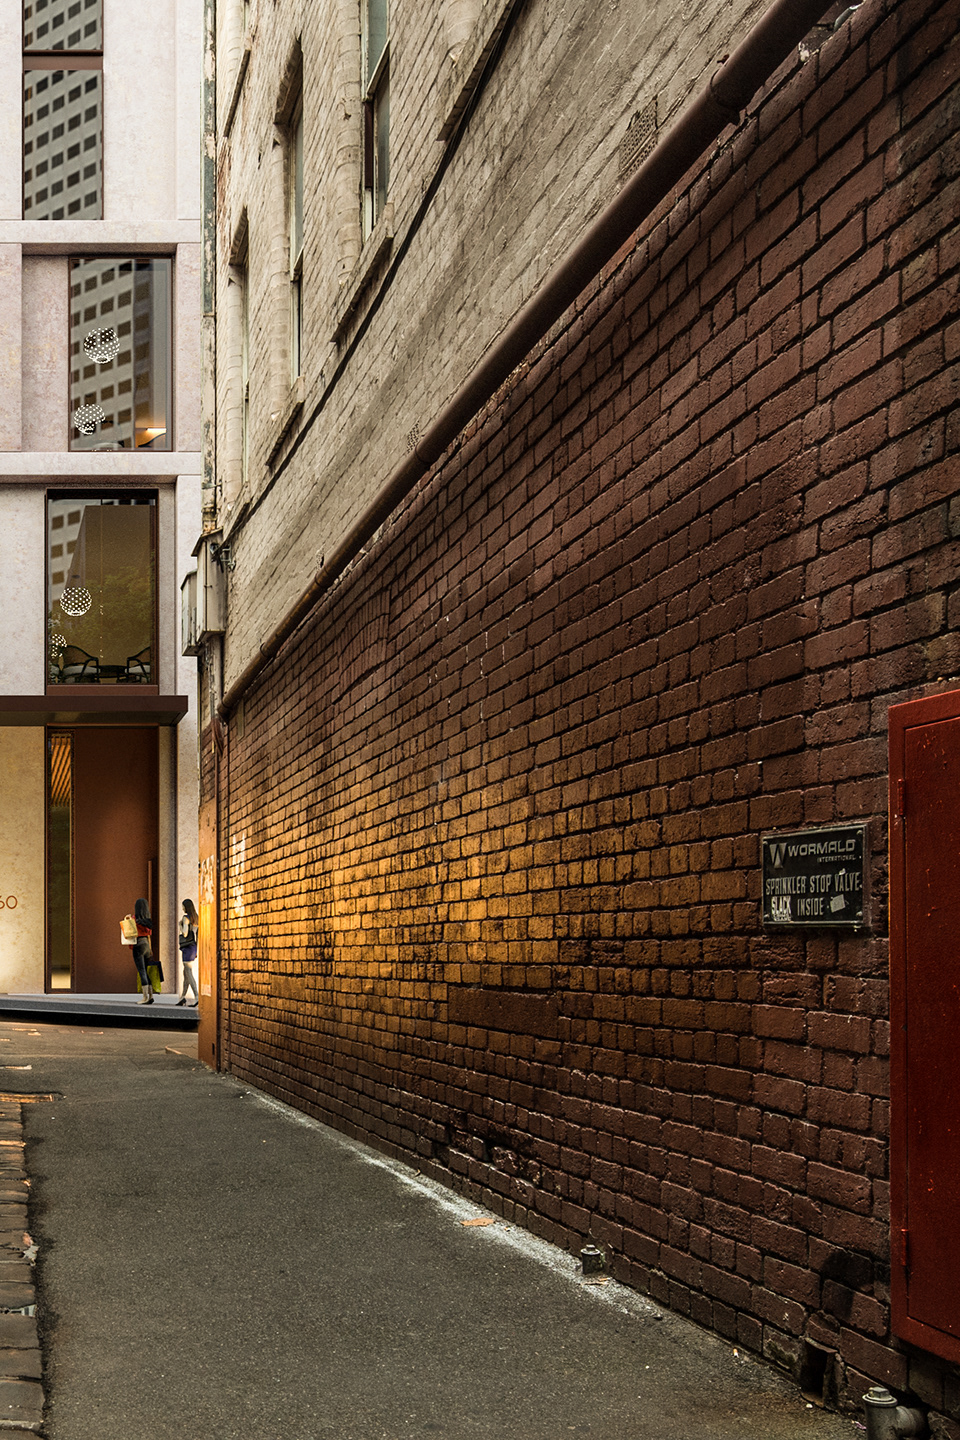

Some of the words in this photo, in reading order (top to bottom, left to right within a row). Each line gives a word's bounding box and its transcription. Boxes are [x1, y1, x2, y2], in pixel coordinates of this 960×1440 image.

[788, 839, 856, 857] WORMALD
[766, 876, 806, 895] SPRINKLER
[809, 874, 832, 894] STOP
[834, 872, 861, 892] VALVE
[797, 897, 824, 916] INSIDE
